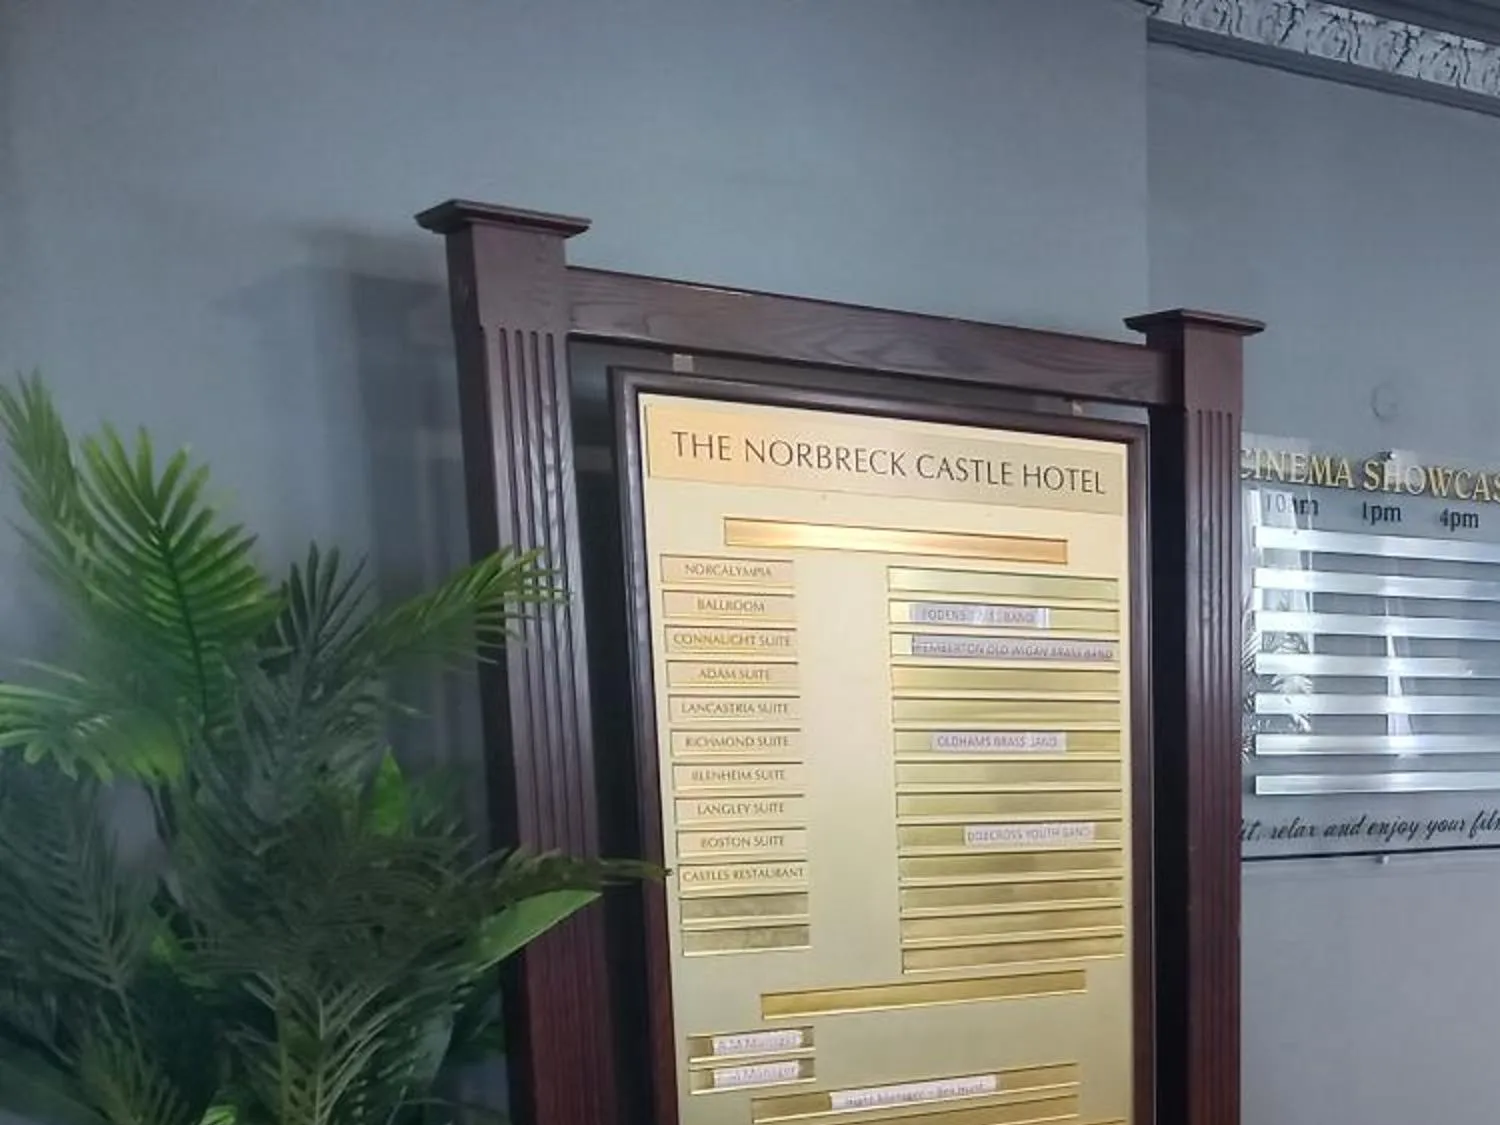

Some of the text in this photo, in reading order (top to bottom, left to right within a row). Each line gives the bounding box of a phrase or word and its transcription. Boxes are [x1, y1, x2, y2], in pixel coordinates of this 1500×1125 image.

[671, 431, 1106, 495] THE NORBRECK CASTLE HOTEL
[1362, 504, 1401, 527] 1pm
[1440, 509, 1480, 531] 4pm
[697, 599, 765, 612] BALLROOM
[673, 633, 791, 647] CONNAUGHT SUITE
[700, 669, 770, 681] ADAM SUITE
[681, 703, 788, 714] LANCASTRIA SUITE
[685, 735, 789, 748] RICHMOND SUITE
[691, 769, 786, 781] BLENHEIM SUITE
[697, 802, 784, 815] LANGLEY SUITE
[1239, 819, 1260, 841] it,
[1324, 815, 1365, 837] and
[1366, 818, 1420, 842] enjoy
[1427, 818, 1466, 840] your
[701, 835, 784, 849] BOSTON SUITE
[682, 870, 730, 883] CASTLES
